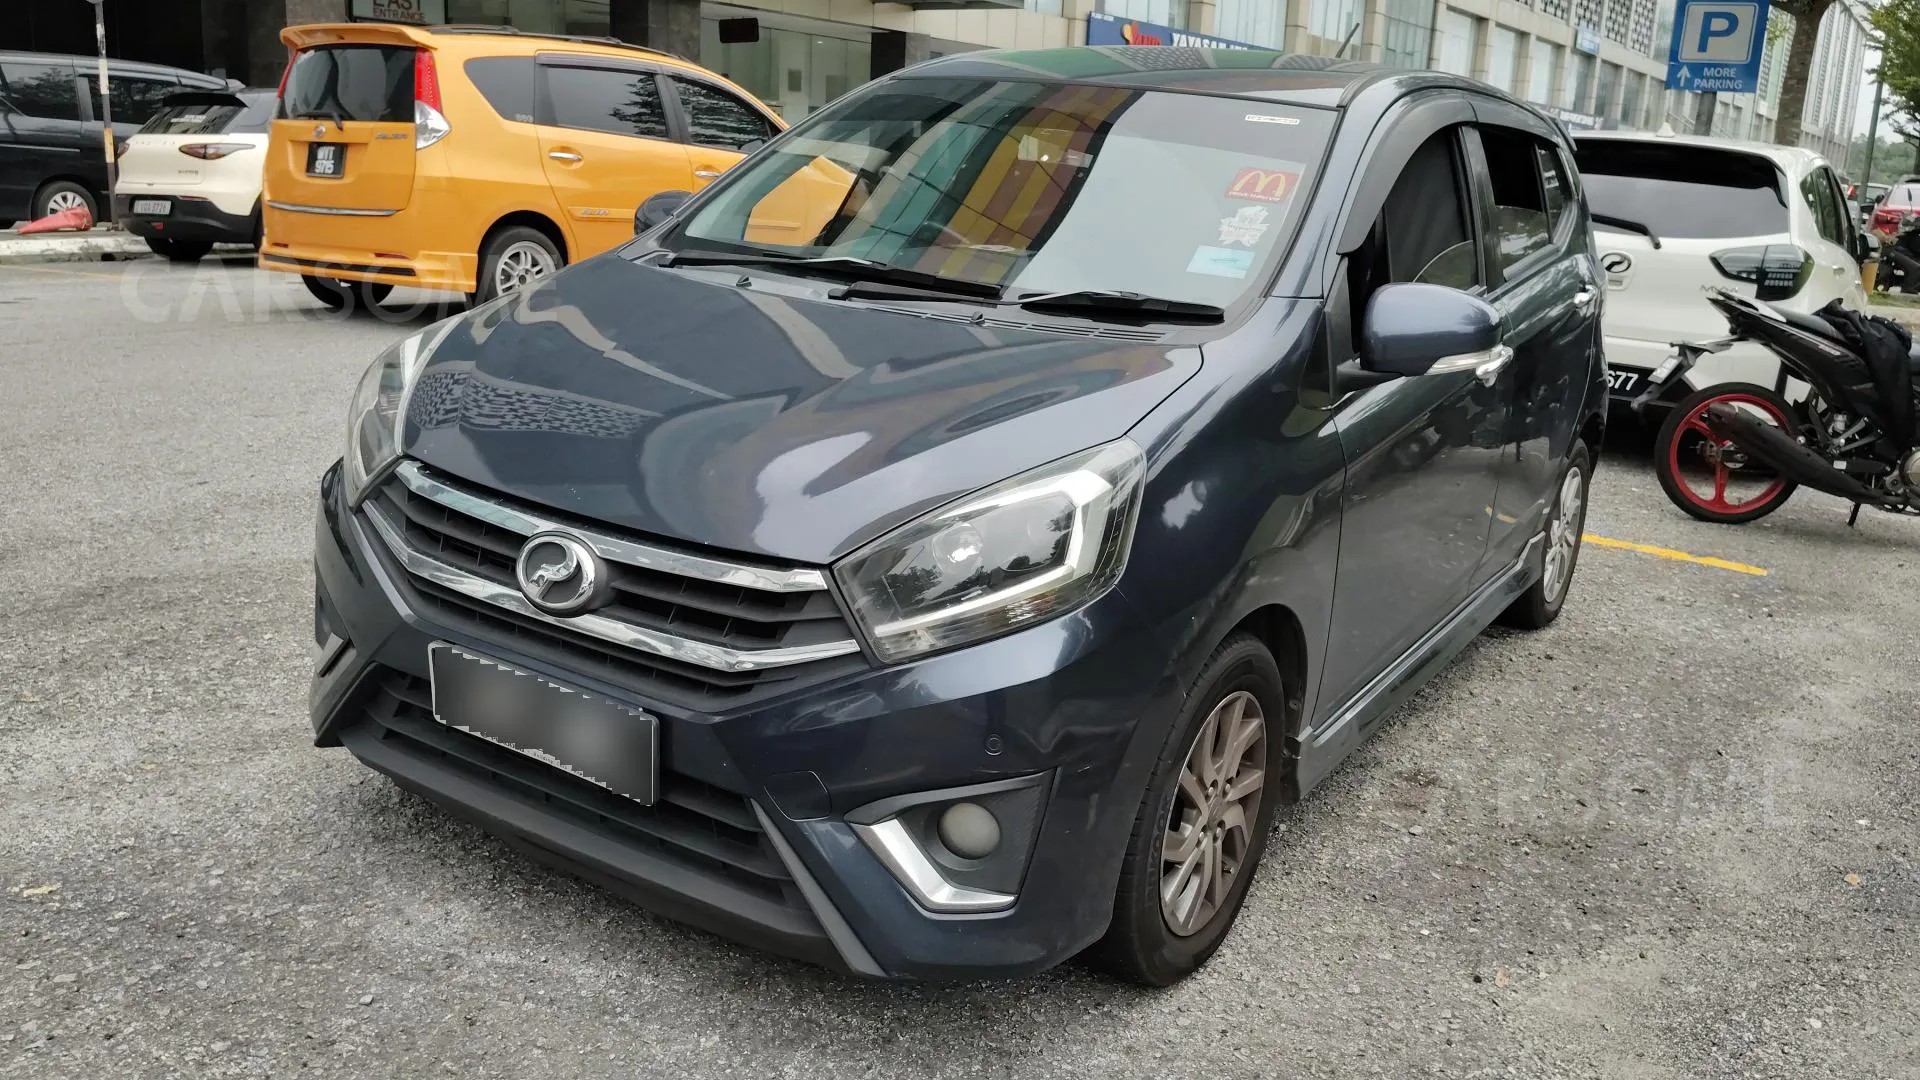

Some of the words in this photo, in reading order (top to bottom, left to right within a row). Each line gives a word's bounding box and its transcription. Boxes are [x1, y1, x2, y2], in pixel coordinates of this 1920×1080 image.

[1697, 11, 1740, 53] P
[1703, 67, 1738, 77] MORE
[1693, 78, 1744, 90] PARKING
